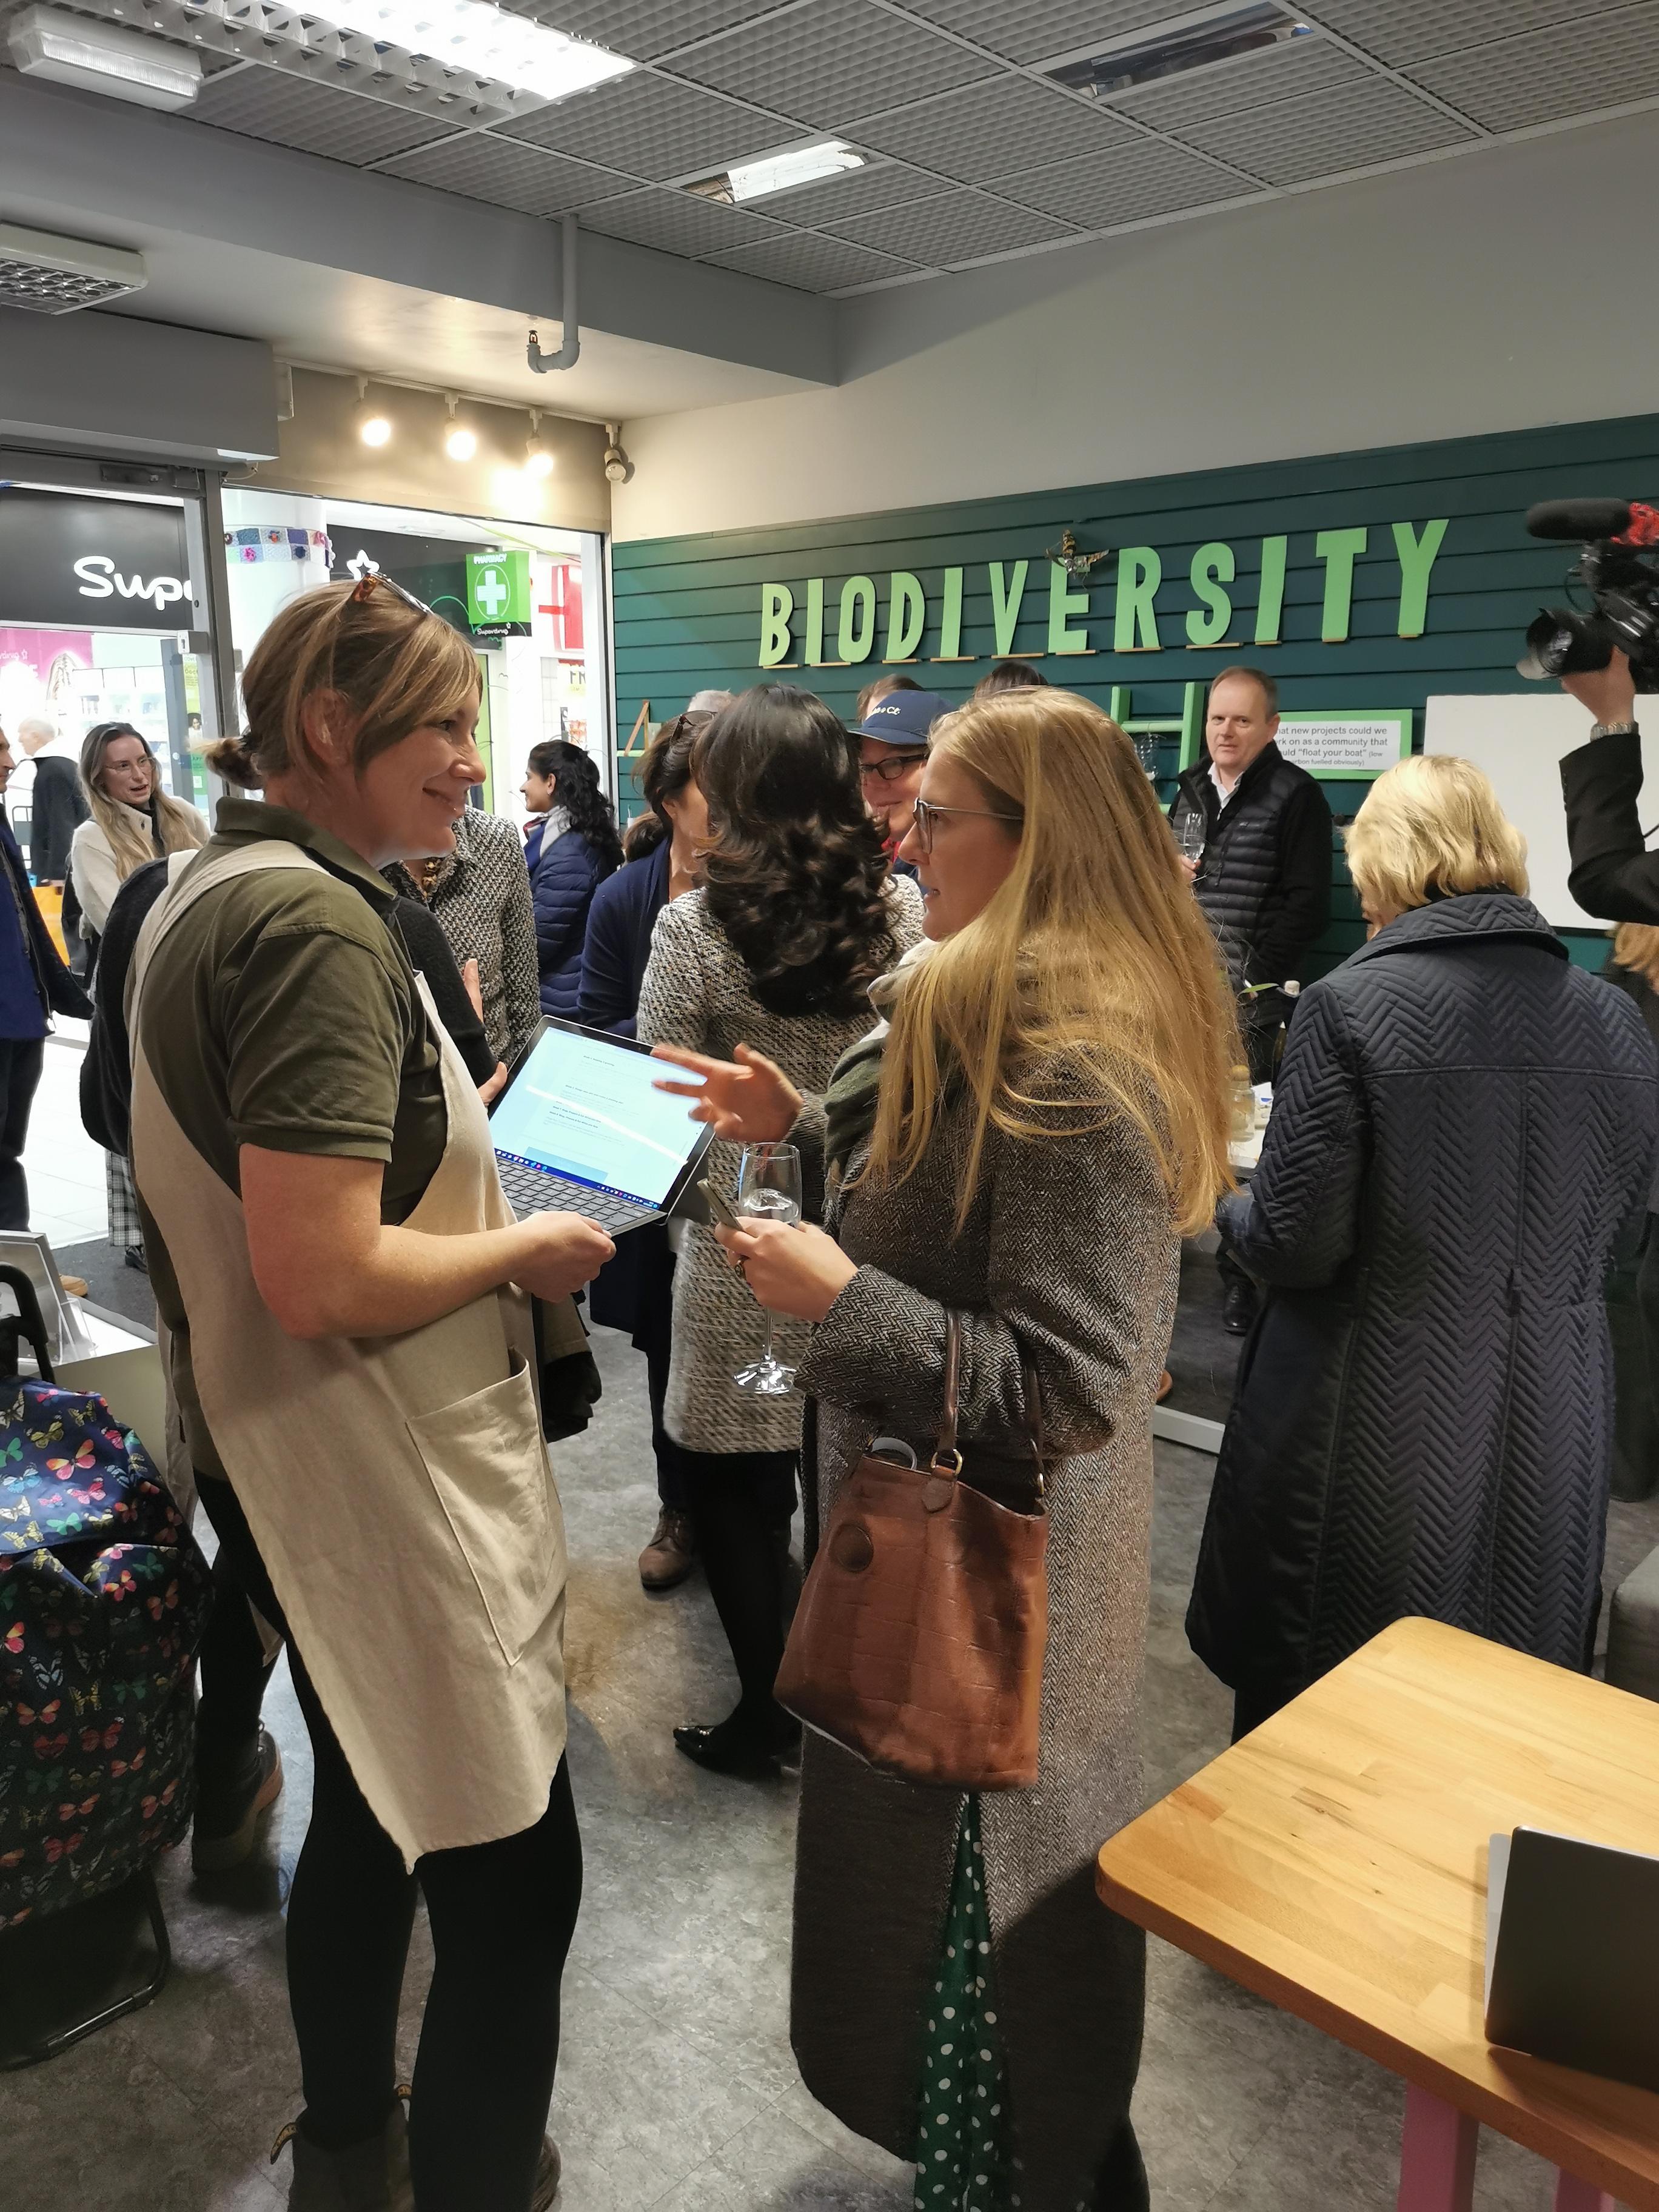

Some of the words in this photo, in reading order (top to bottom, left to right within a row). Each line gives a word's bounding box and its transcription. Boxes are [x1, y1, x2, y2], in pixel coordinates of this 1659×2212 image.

[474, 554, 508, 565] PHARMACY
[758, 520, 1449, 666] BIODIVERSITY
[477, 628, 509, 636] Superdrug
[1311, 726, 1347, 736] projects
[1349, 726, 1372, 735] could
[1321, 738, 1368, 748] community
[1370, 737, 1388, 746] that
[1282, 748, 1296, 757] uld
[1333, 759, 1365, 767] obviously)
